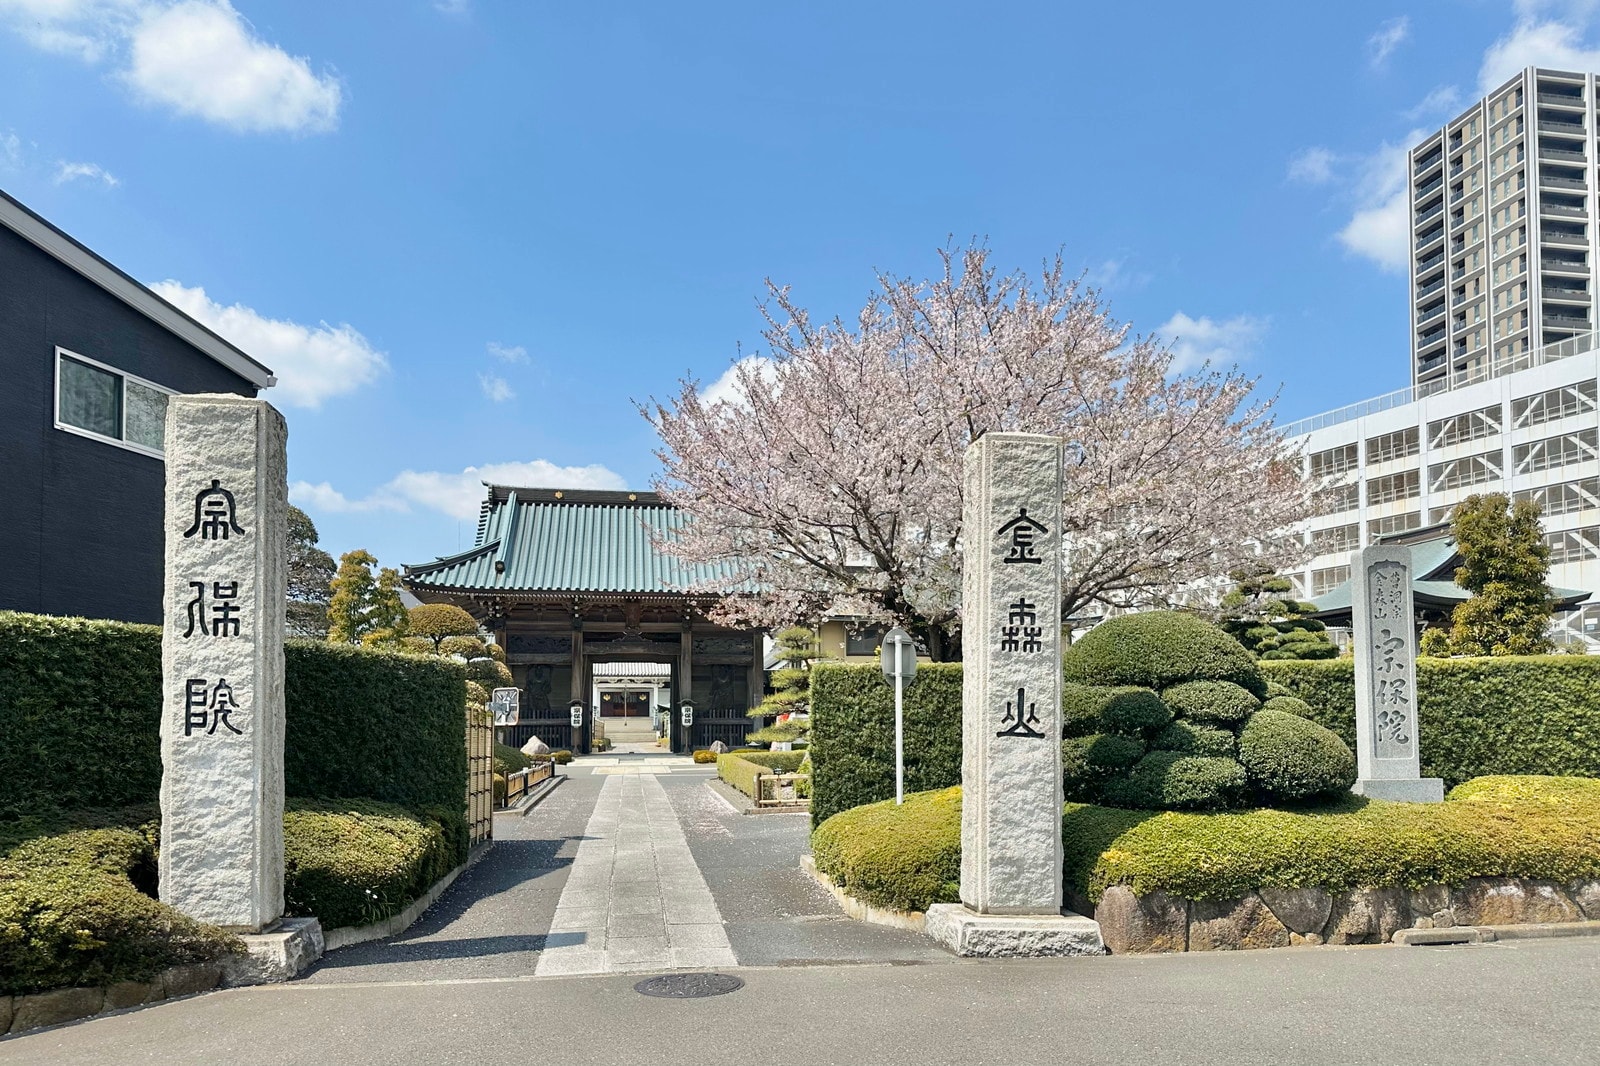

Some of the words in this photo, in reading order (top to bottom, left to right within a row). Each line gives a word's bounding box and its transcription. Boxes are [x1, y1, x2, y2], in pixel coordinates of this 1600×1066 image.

[183, 479, 246, 737] 宗保院
[996, 507, 1049, 739] 金森山
[1374, 628, 1410, 745] 宗保院
